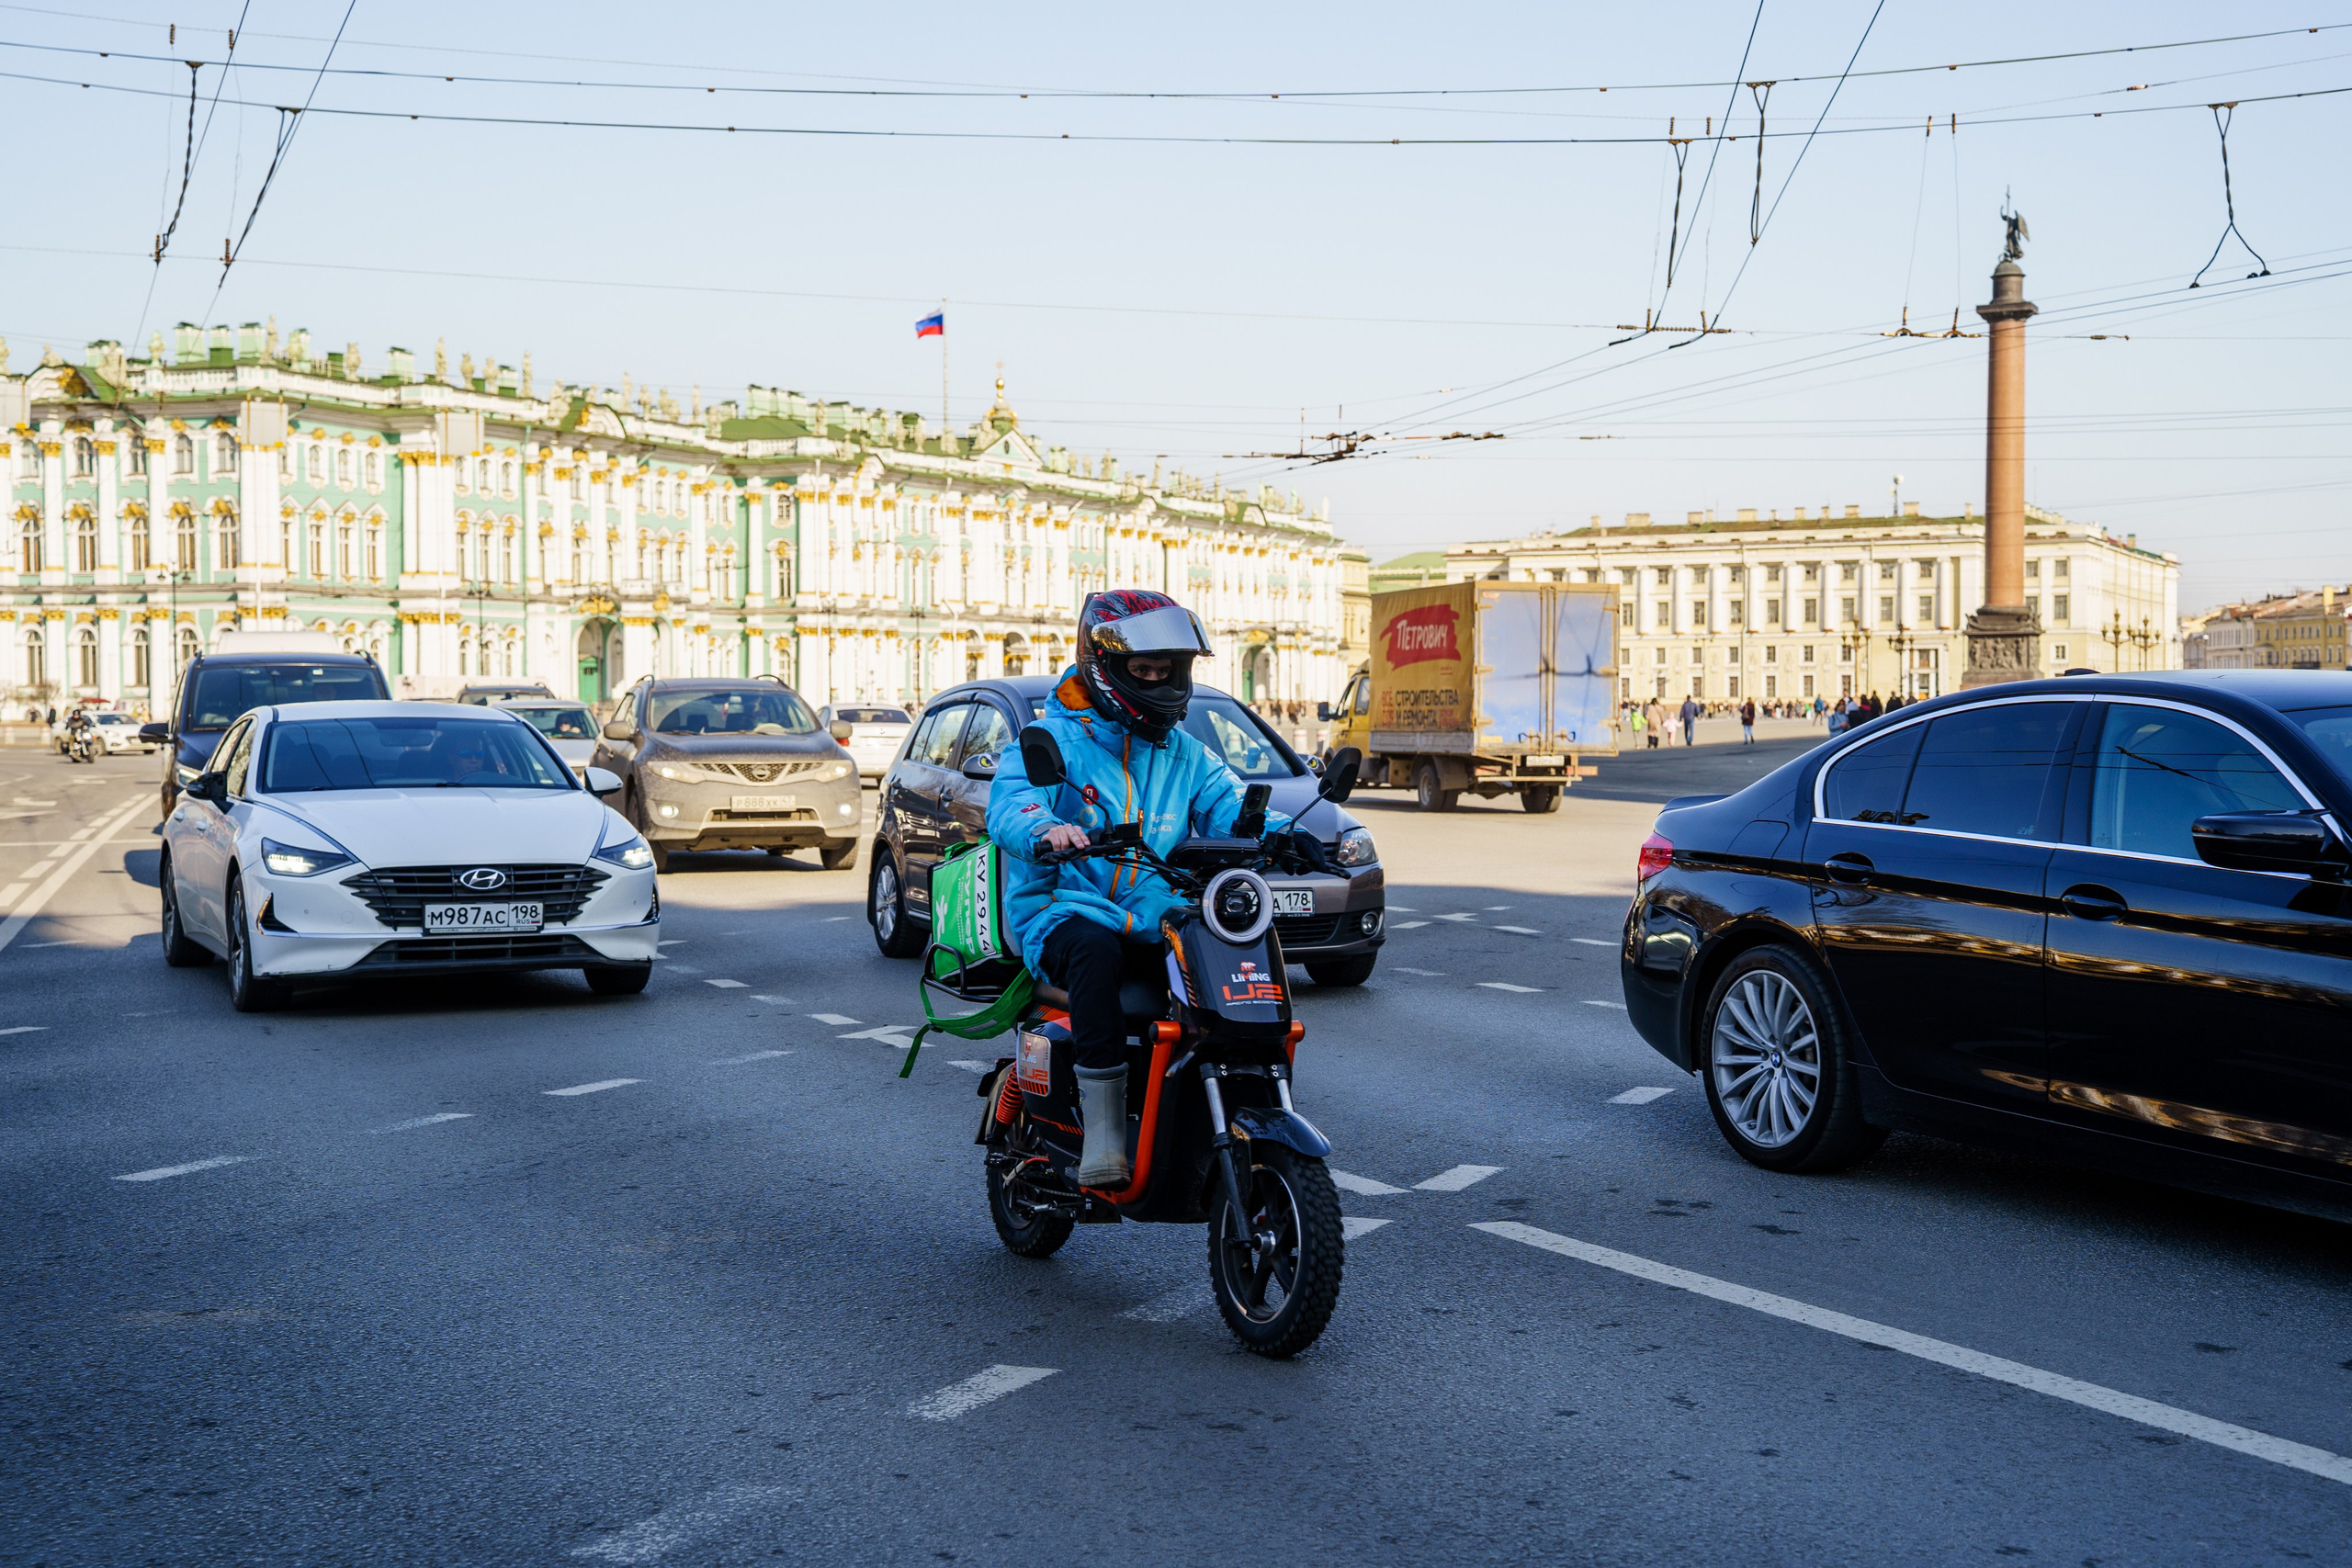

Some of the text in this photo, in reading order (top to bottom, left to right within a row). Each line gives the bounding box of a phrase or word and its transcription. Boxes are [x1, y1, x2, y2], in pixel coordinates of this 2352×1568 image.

[1396, 689, 1459, 706] СТРОИТЕЛЬСТВА
[1285, 893, 1308, 907] 178
[430, 905, 538, 926] М987АС 198
[977, 891, 990, 952] 2944
[1222, 984, 1284, 1000] U2
[1024, 1066, 1048, 1082] U2
